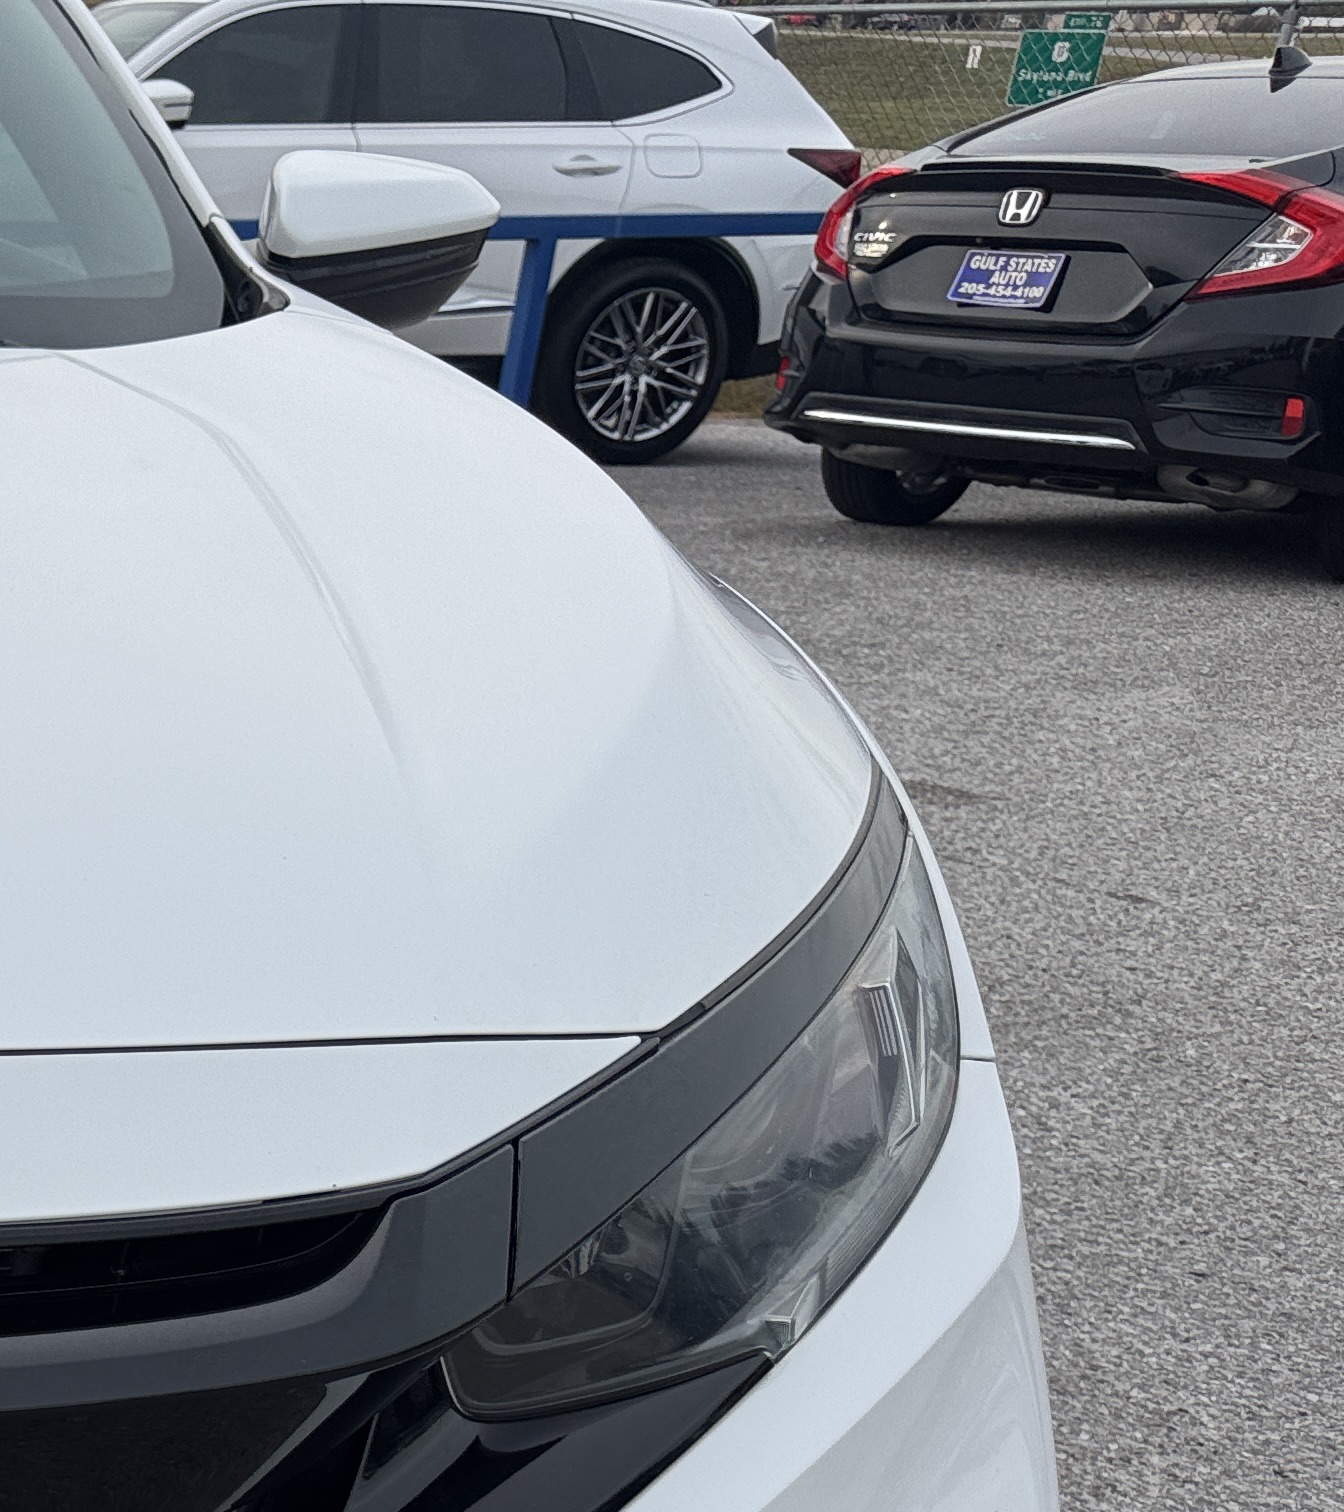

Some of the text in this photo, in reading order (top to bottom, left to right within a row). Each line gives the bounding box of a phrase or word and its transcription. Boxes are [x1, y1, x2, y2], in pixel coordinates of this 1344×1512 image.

[970, 254, 1056, 272] GULF STATES
[989, 271, 1027, 285] AUTO
[958, 282, 1044, 298] 205-454-4100
